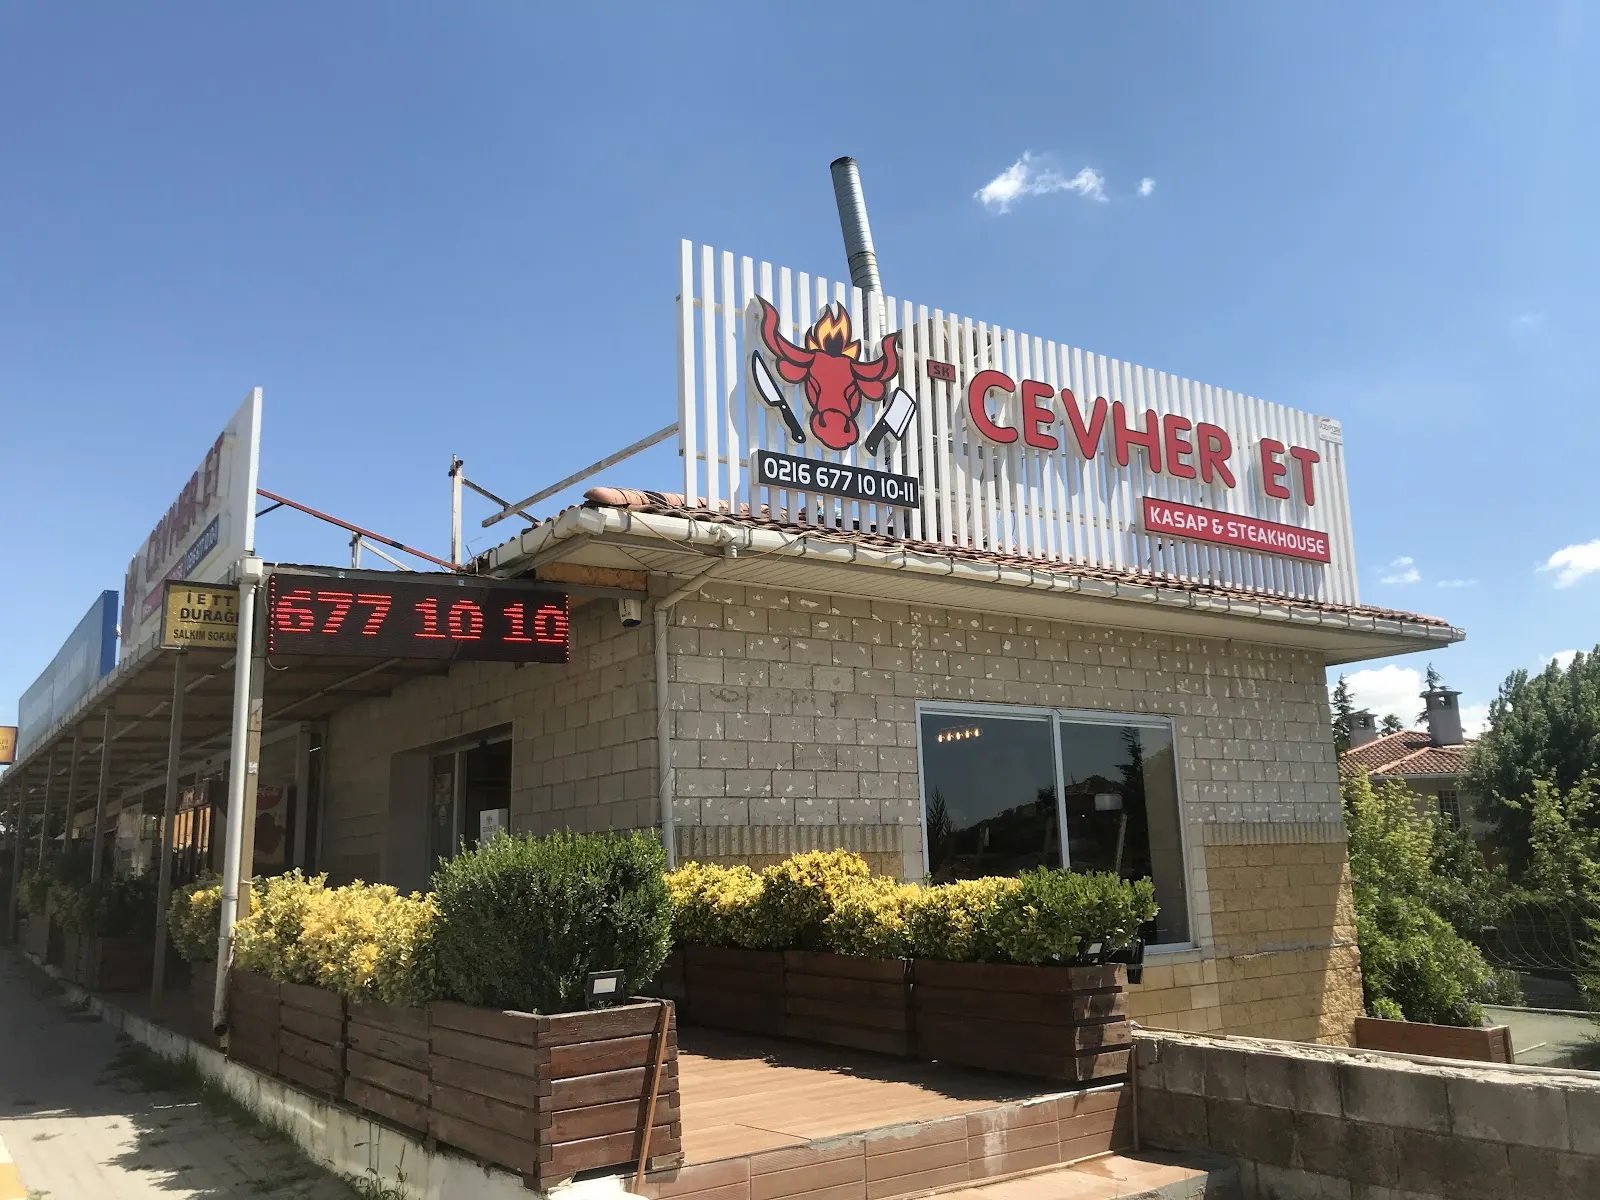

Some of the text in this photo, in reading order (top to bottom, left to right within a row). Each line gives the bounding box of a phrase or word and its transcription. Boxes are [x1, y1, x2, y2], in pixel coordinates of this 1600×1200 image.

[933, 365, 950, 378] SK
[968, 370, 1321, 507] CEVHER ET
[763, 457, 914, 502] 0216 677 10 10-11
[1150, 506, 1326, 555] KASAP & STEAKHOUSE
[173, 629, 206, 640] SALKIM
[276, 590, 568, 642] 677 10 10
